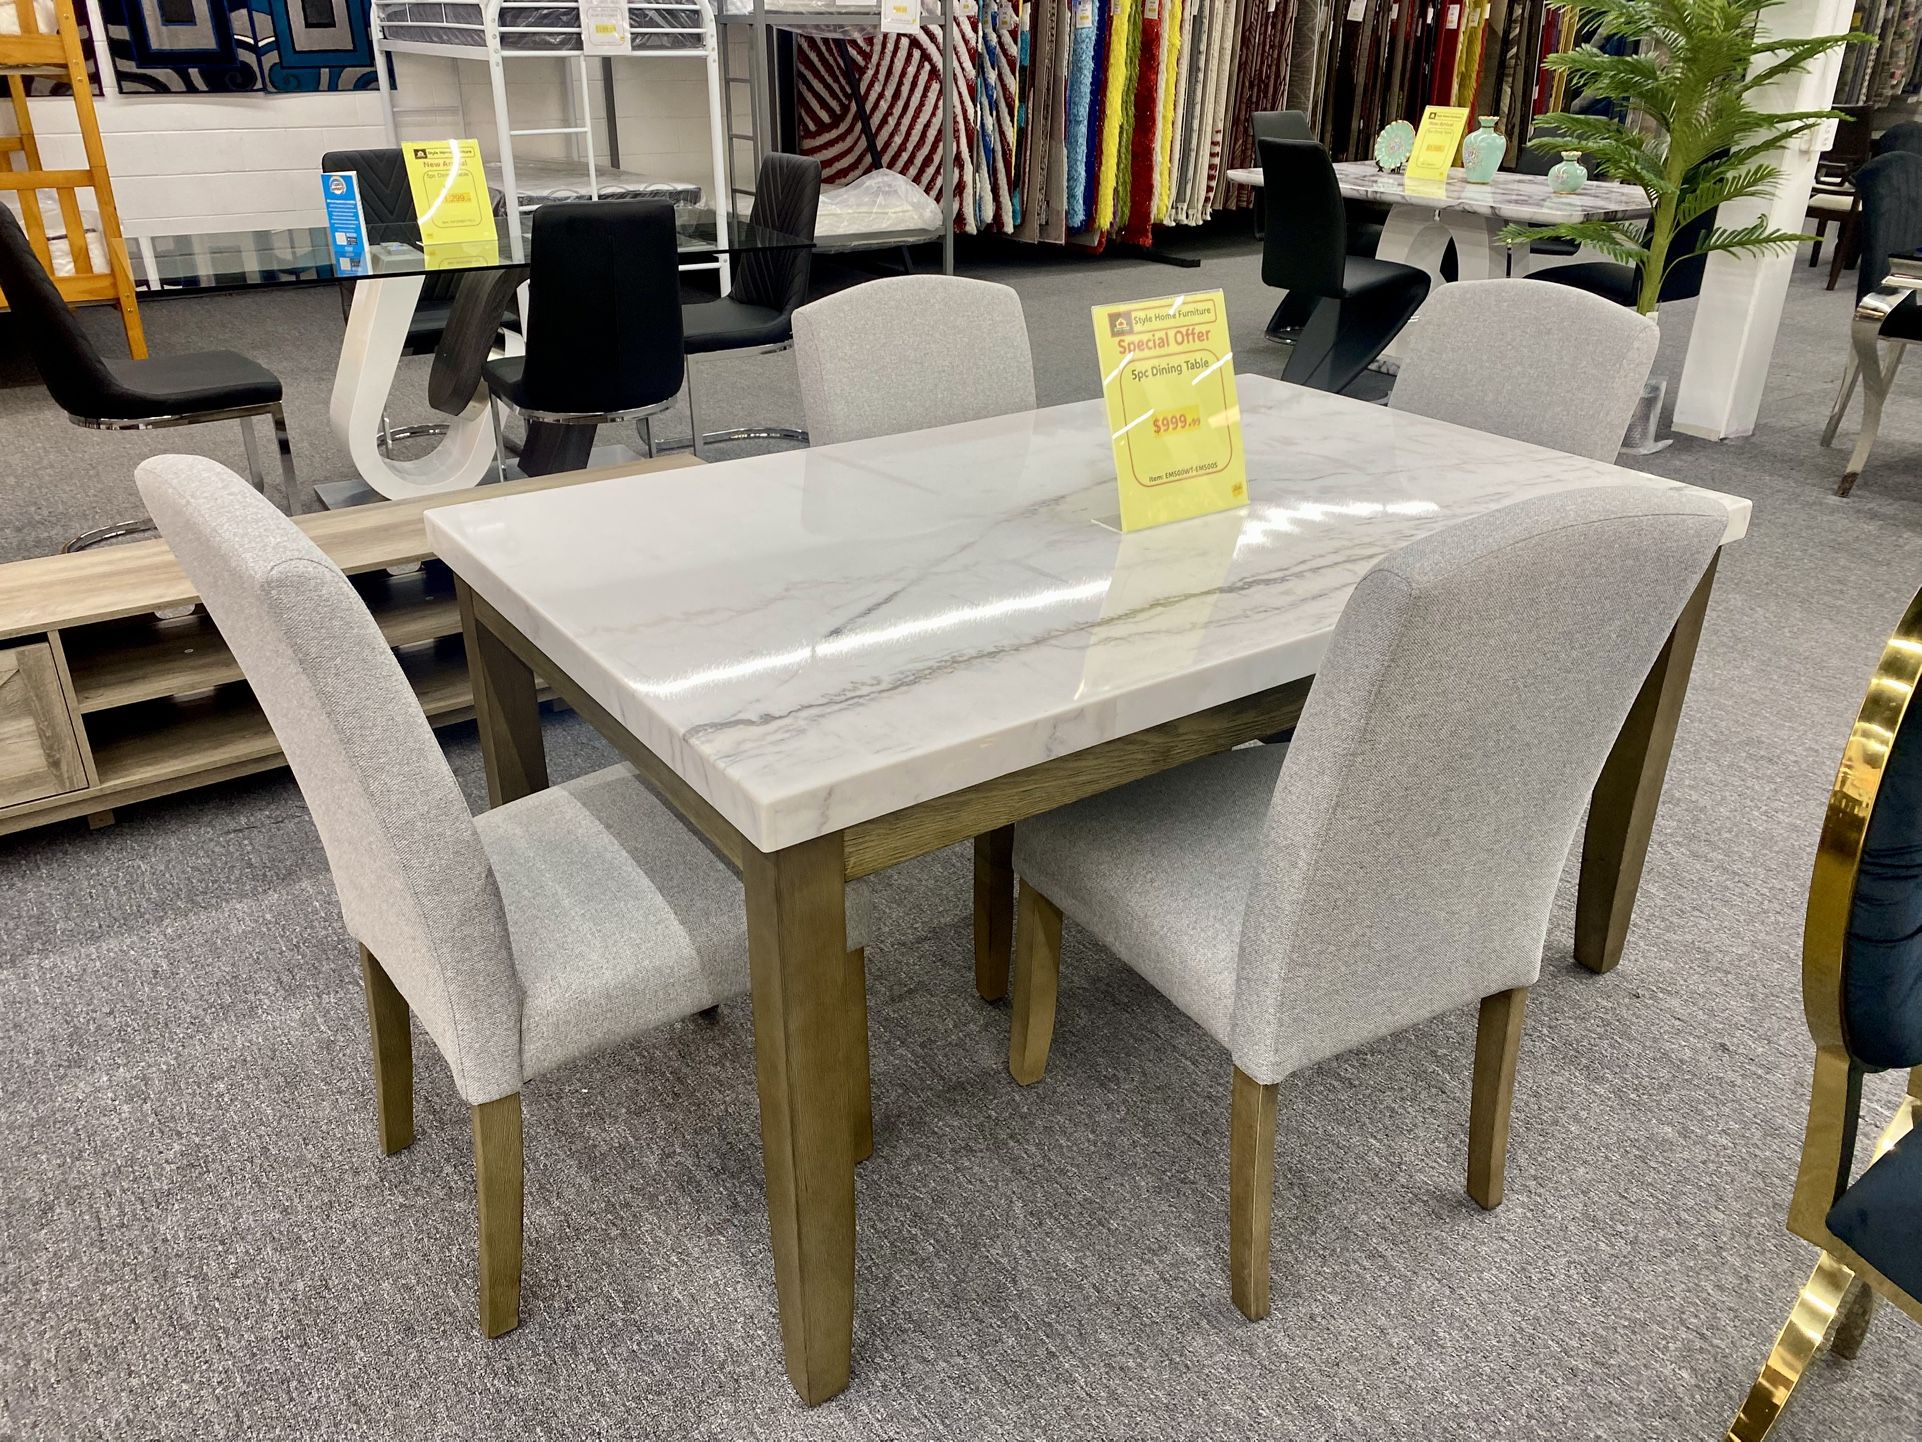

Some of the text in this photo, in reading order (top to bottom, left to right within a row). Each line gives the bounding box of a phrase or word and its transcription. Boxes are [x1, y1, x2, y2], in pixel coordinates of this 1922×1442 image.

[1133, 306, 1211, 325] Style Home Furniture
[1117, 327, 1211, 355] Special Offer
[1131, 358, 1210, 382] 5pc Dining Table
[1153, 414, 1200, 434] $999.99
[1149, 475, 1164, 483] Item:
